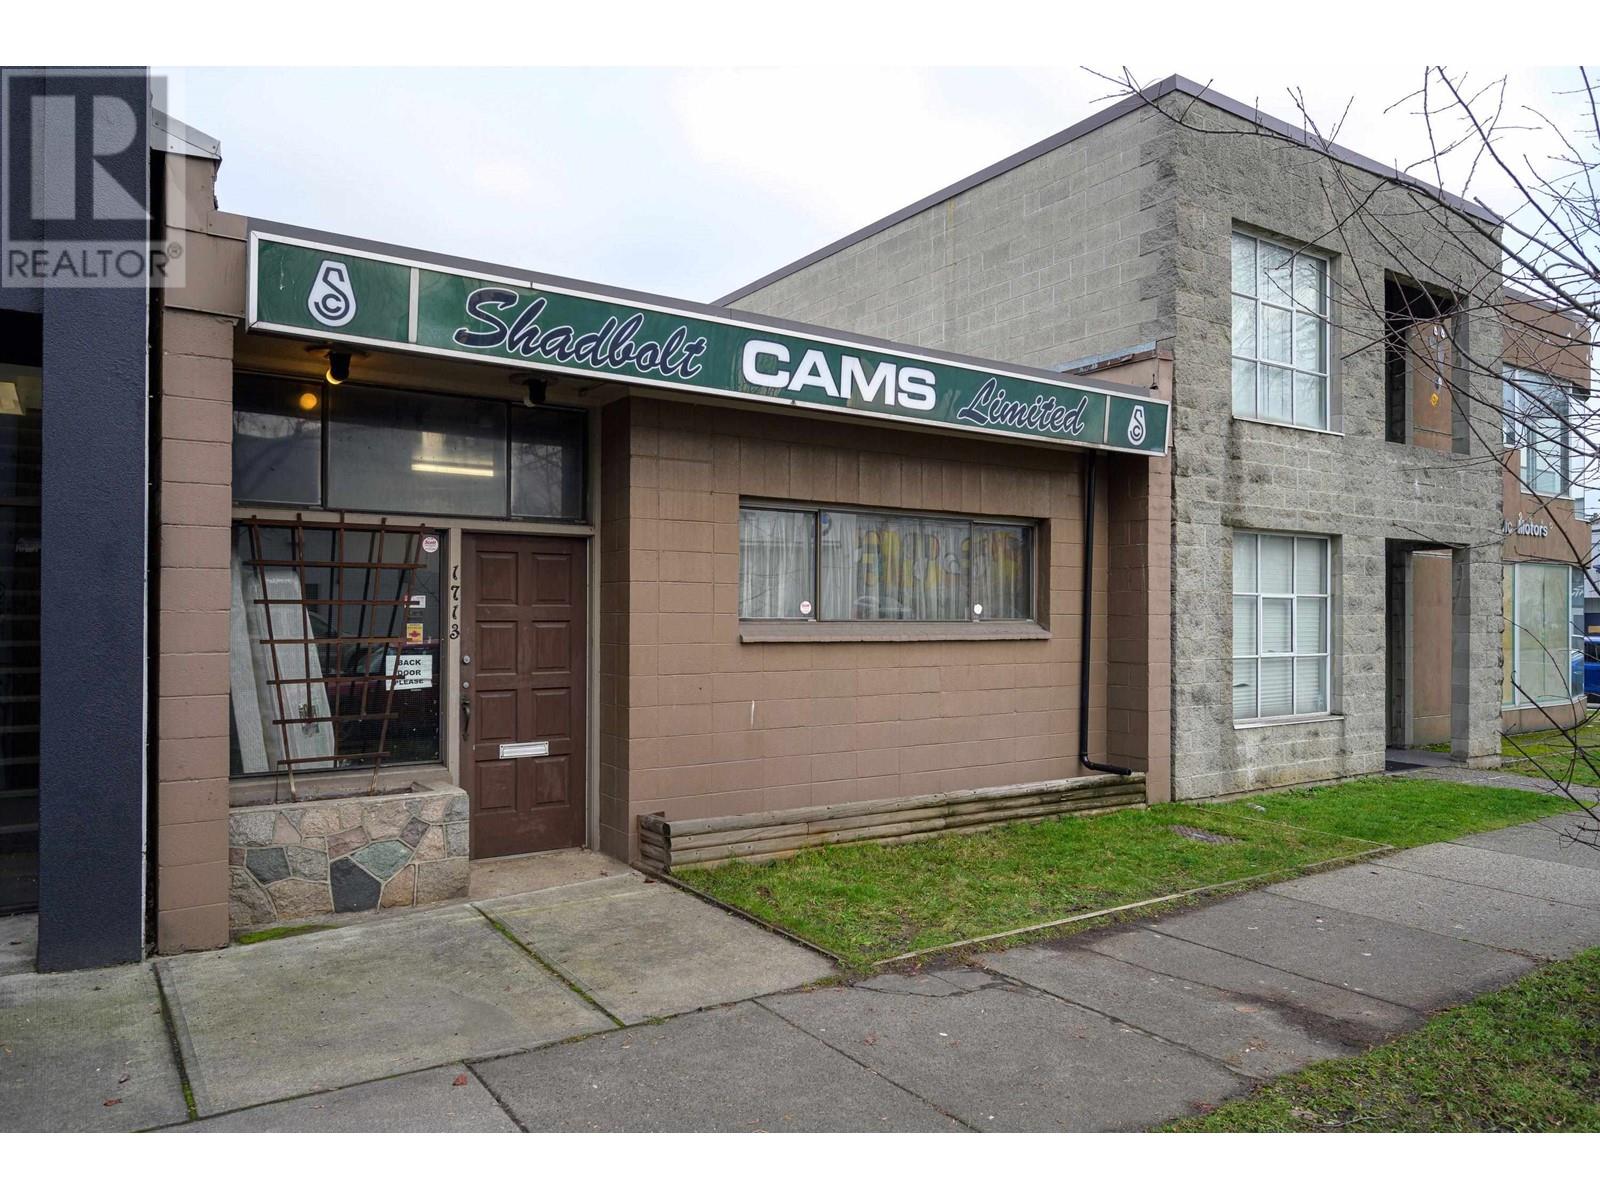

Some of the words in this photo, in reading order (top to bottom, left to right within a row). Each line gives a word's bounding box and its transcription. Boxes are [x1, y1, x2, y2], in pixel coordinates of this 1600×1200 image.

[453, 287, 708, 379] Shadbolt
[742, 339, 936, 411] CAMS
[956, 377, 1089, 437] Limited
[450, 564, 460, 640] 1713
